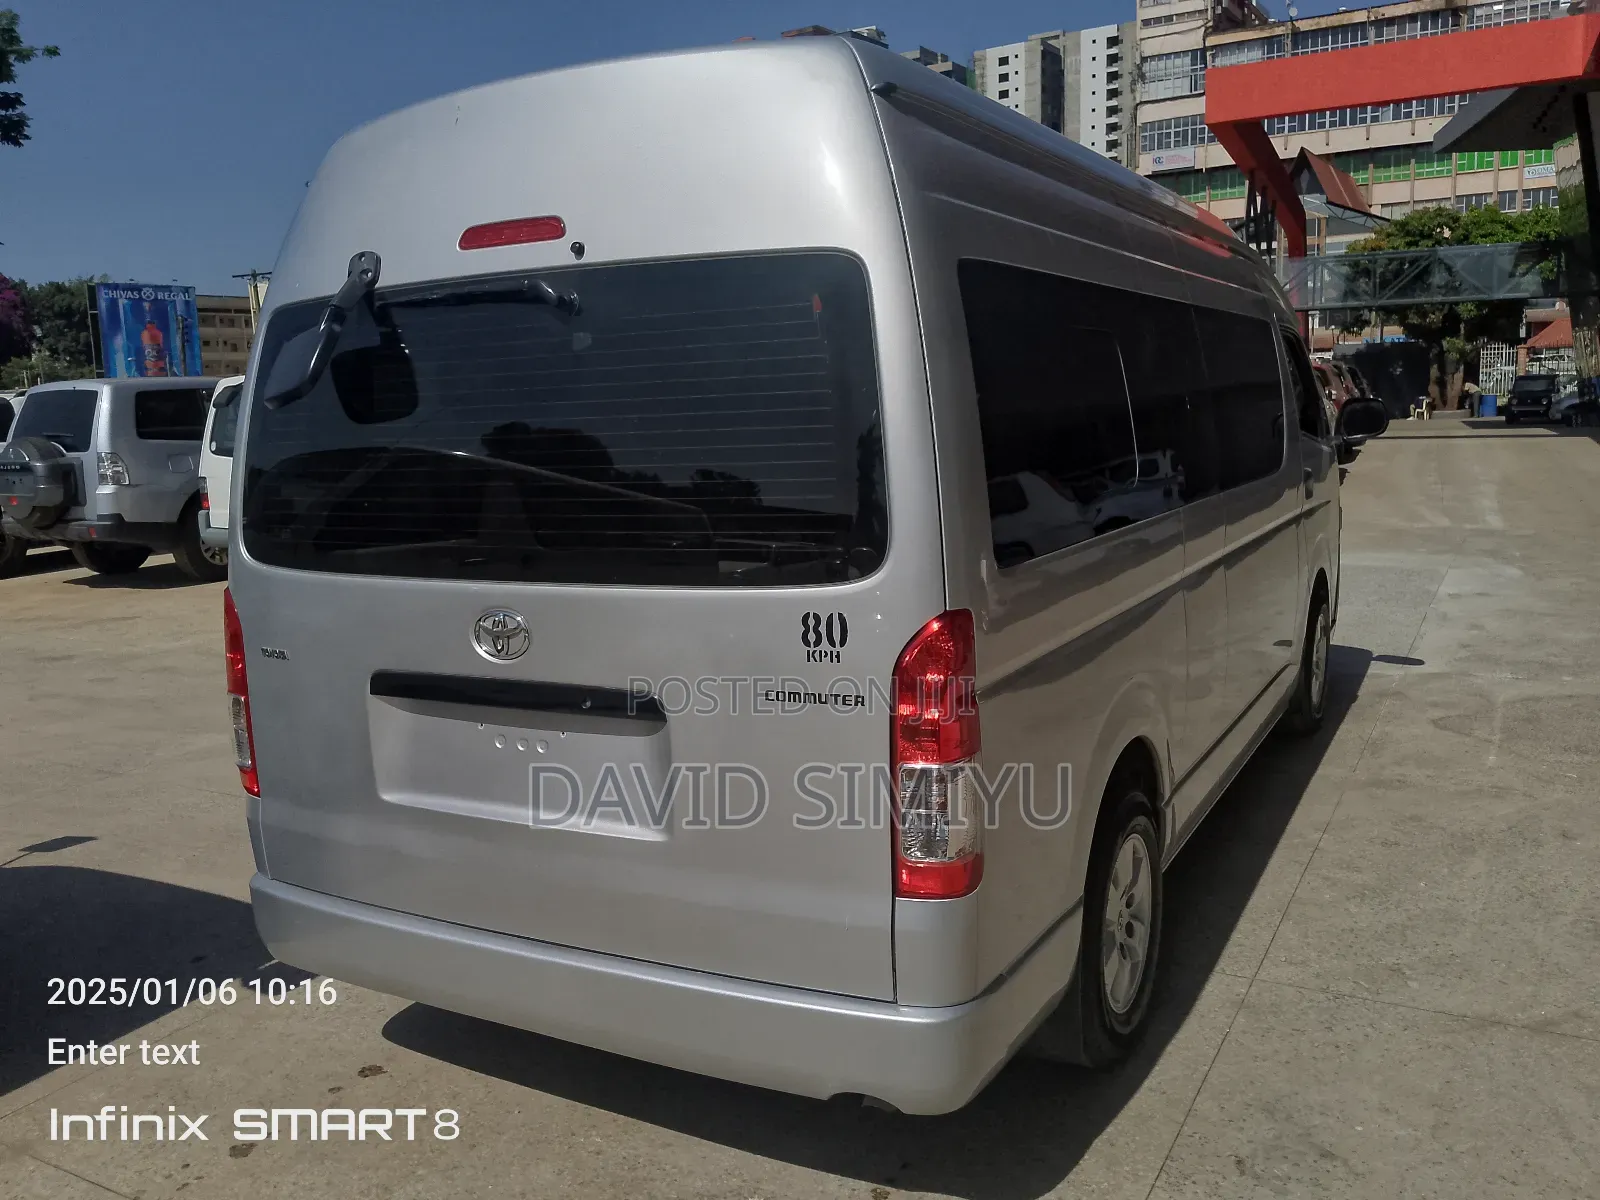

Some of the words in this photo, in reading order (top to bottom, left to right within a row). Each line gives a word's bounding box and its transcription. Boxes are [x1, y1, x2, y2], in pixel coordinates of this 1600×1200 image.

[102, 289, 140, 299] CHIVAS
[157, 291, 191, 300] REGAL
[801, 611, 849, 649] 80
[806, 649, 841, 664] KPH
[764, 690, 866, 707] COMMUTER
